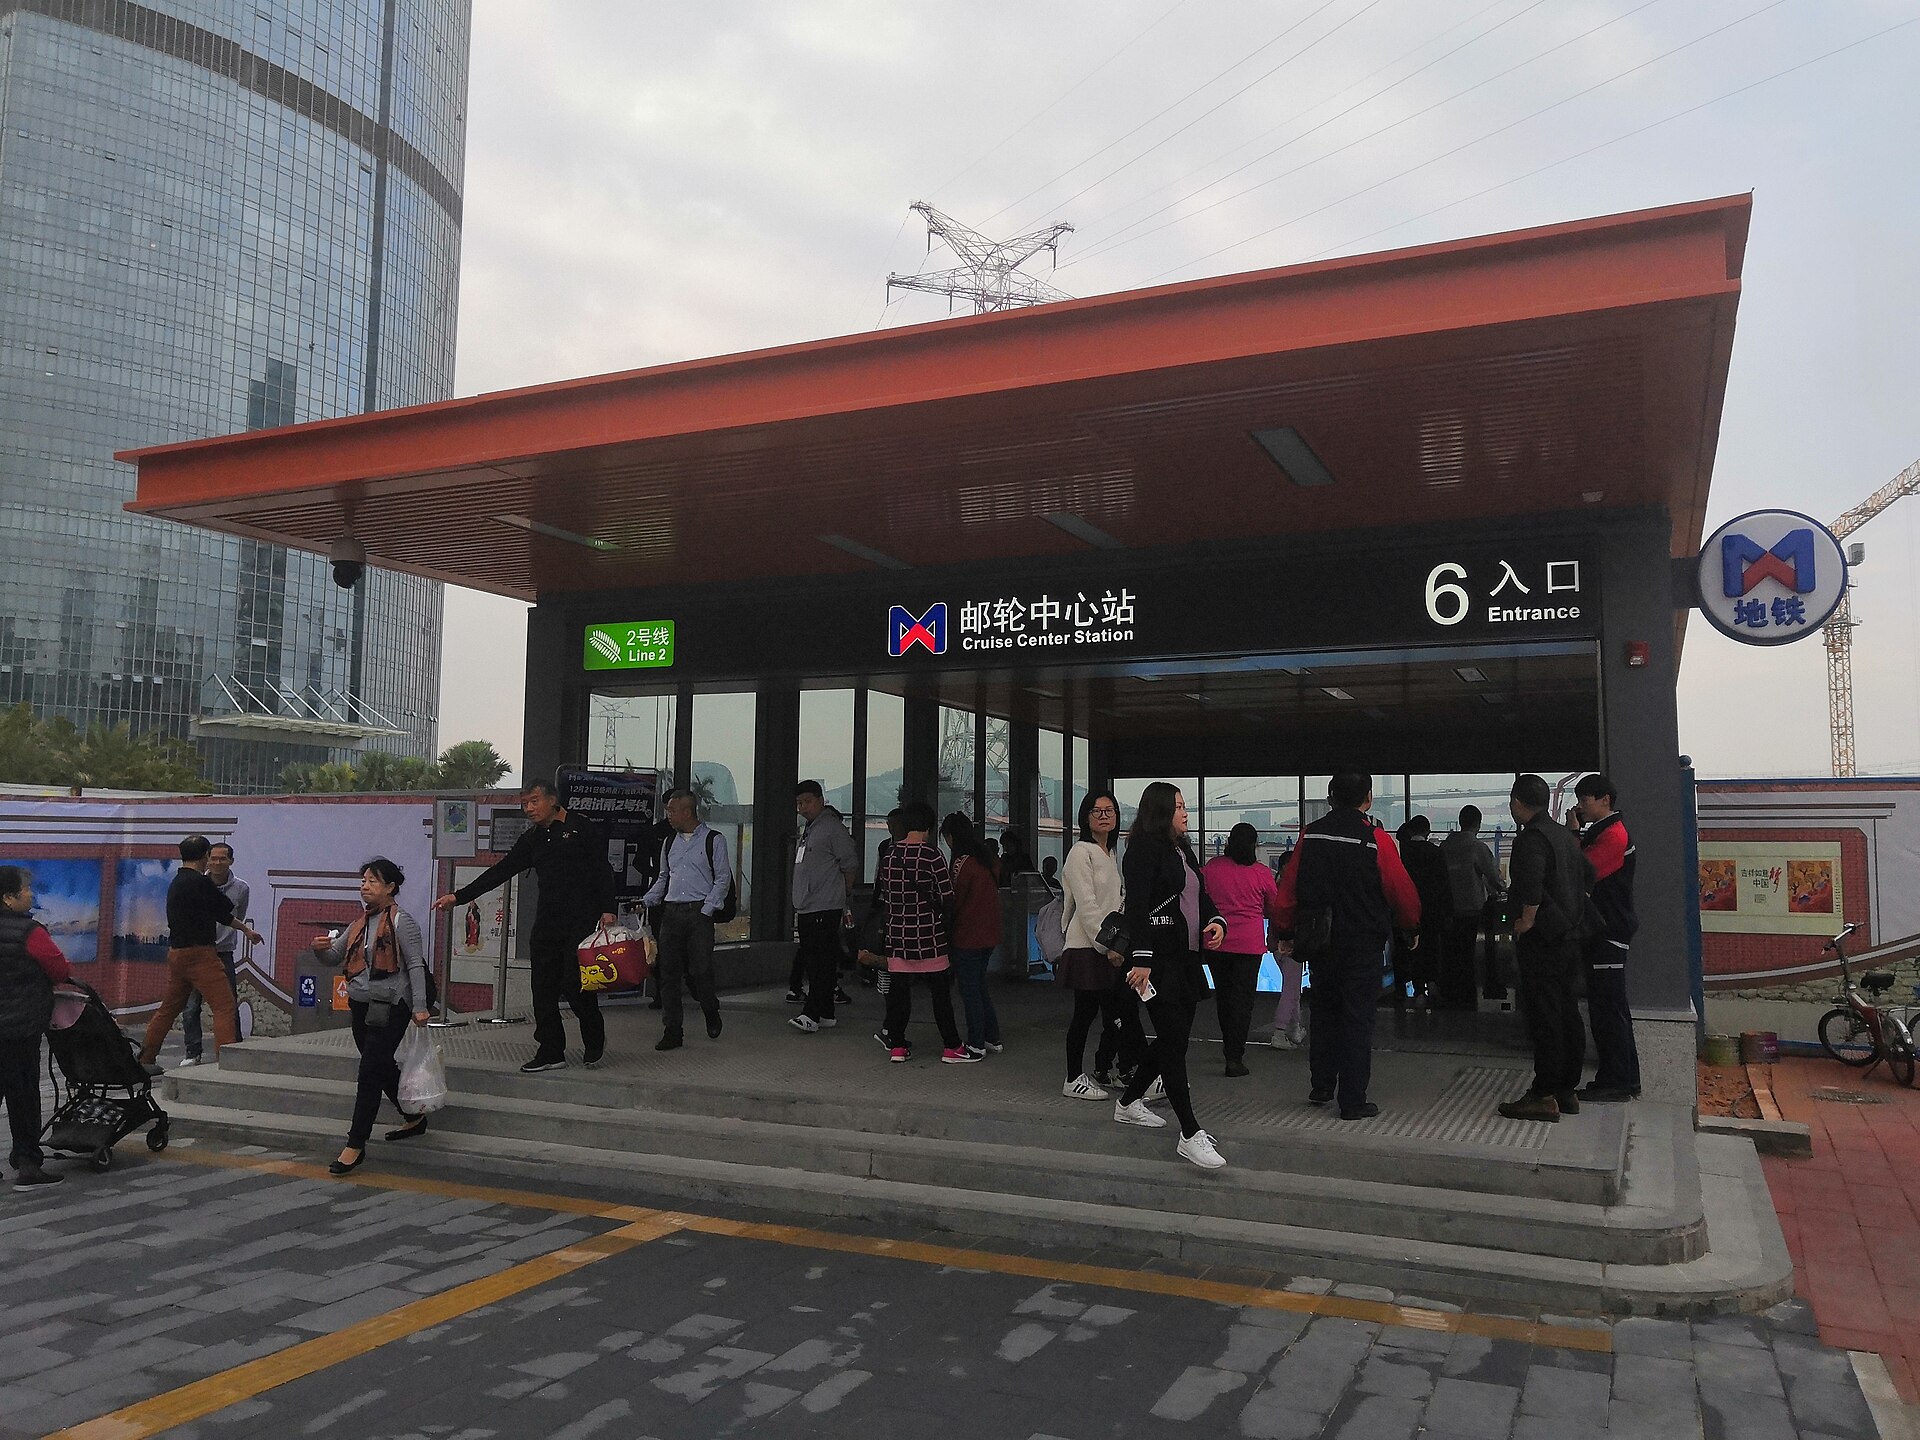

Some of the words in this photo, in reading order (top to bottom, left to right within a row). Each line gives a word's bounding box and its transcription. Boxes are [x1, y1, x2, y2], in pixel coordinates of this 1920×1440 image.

[1489, 559, 1580, 597] 入口
[1425, 562, 1470, 626] 6
[960, 588, 1136, 635] 邮轮中心站
[1488, 604, 1581, 623] Entrance
[1733, 595, 1807, 628] 地铁
[626, 626, 670, 647] 2号线
[962, 636, 1013, 650] Cruise
[1017, 633, 1071, 647] Center
[1074, 628, 1134, 644] Station
[629, 648, 655, 662] Line
[658, 648, 666, 661] 2
[1752, 878, 1769, 889] 中国
